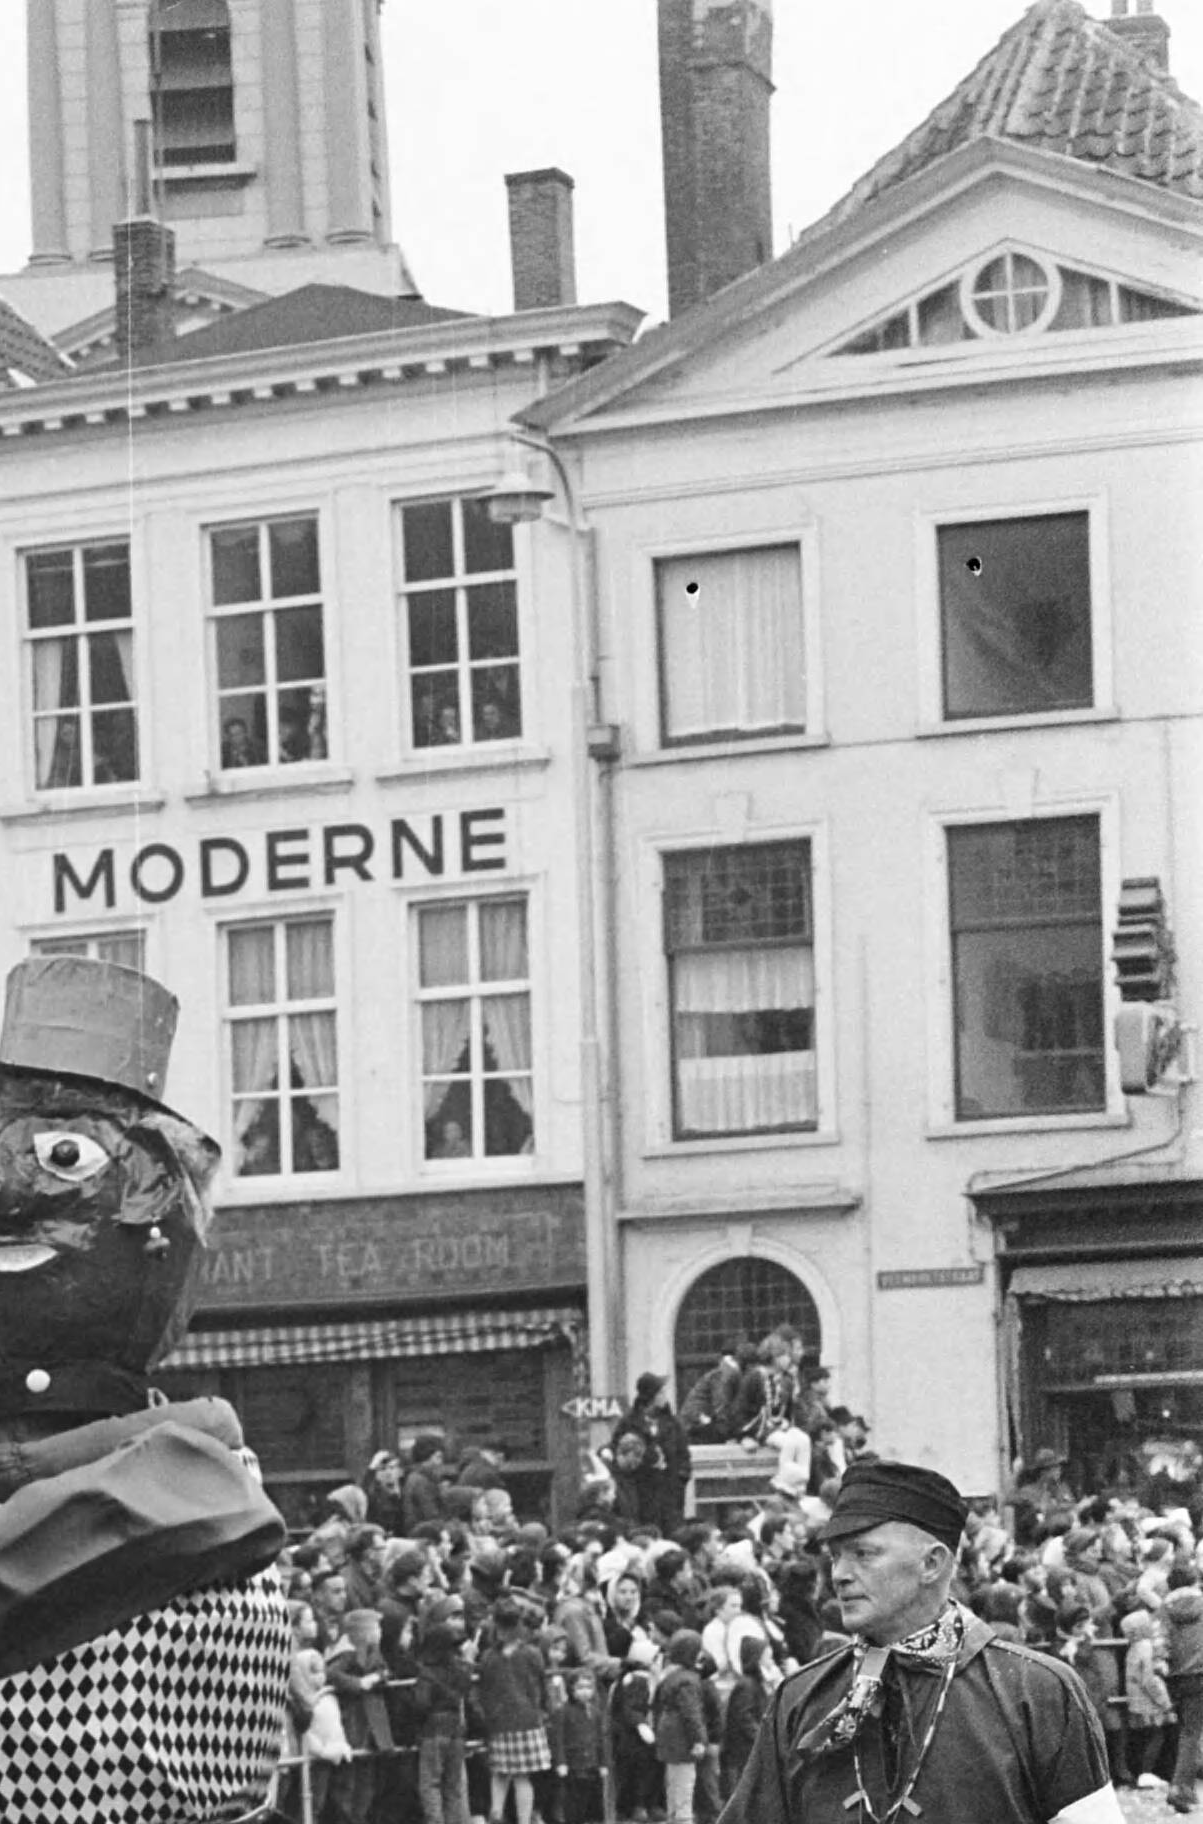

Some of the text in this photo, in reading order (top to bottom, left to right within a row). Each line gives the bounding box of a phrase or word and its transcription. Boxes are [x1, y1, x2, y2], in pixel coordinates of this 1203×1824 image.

[52, 807, 507, 914] MODERNE
[315, 1241, 382, 1277] TEA
[413, 1233, 509, 1271] ROOM
[576, 1397, 624, 1418] KMA
